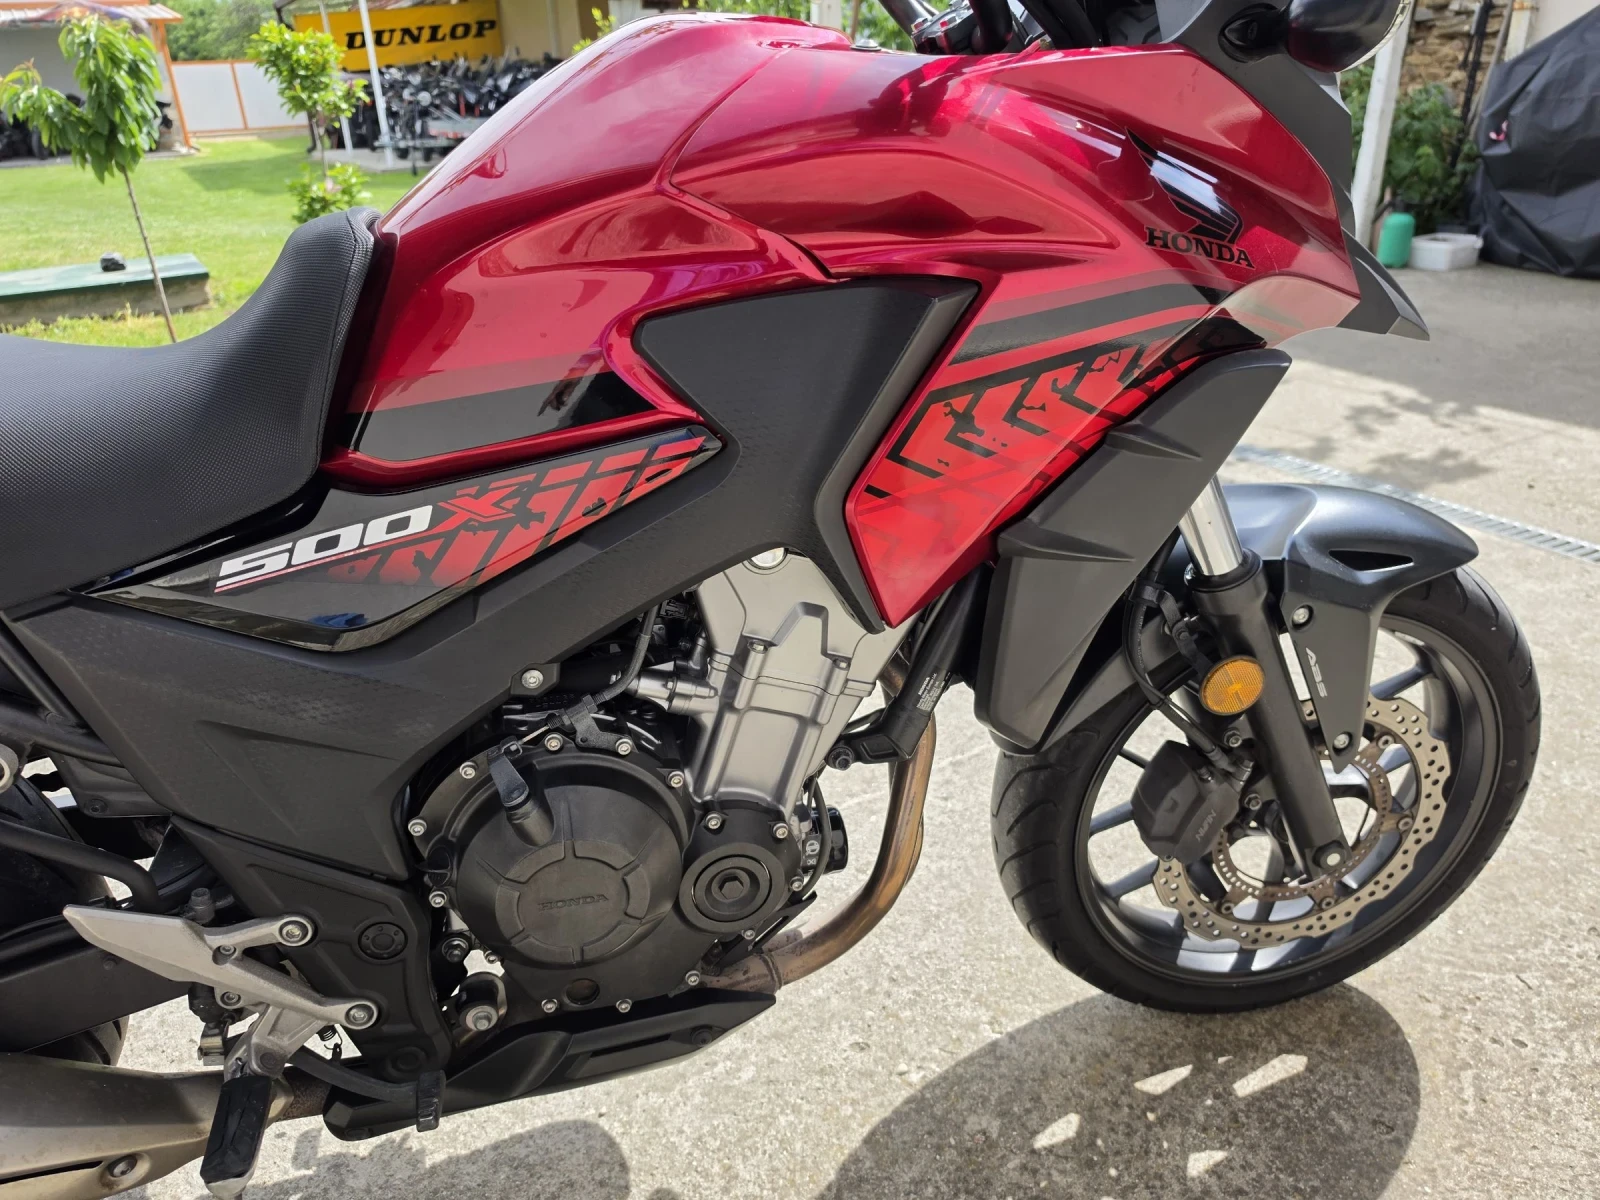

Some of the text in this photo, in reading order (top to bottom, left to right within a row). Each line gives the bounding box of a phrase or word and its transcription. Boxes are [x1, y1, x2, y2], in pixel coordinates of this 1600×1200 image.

[345, 19, 497, 50] DUNLOP
[1145, 226, 1255, 269] HONDA
[1305, 647, 1328, 698] ABS
[537, 894, 609, 912] HONDA
